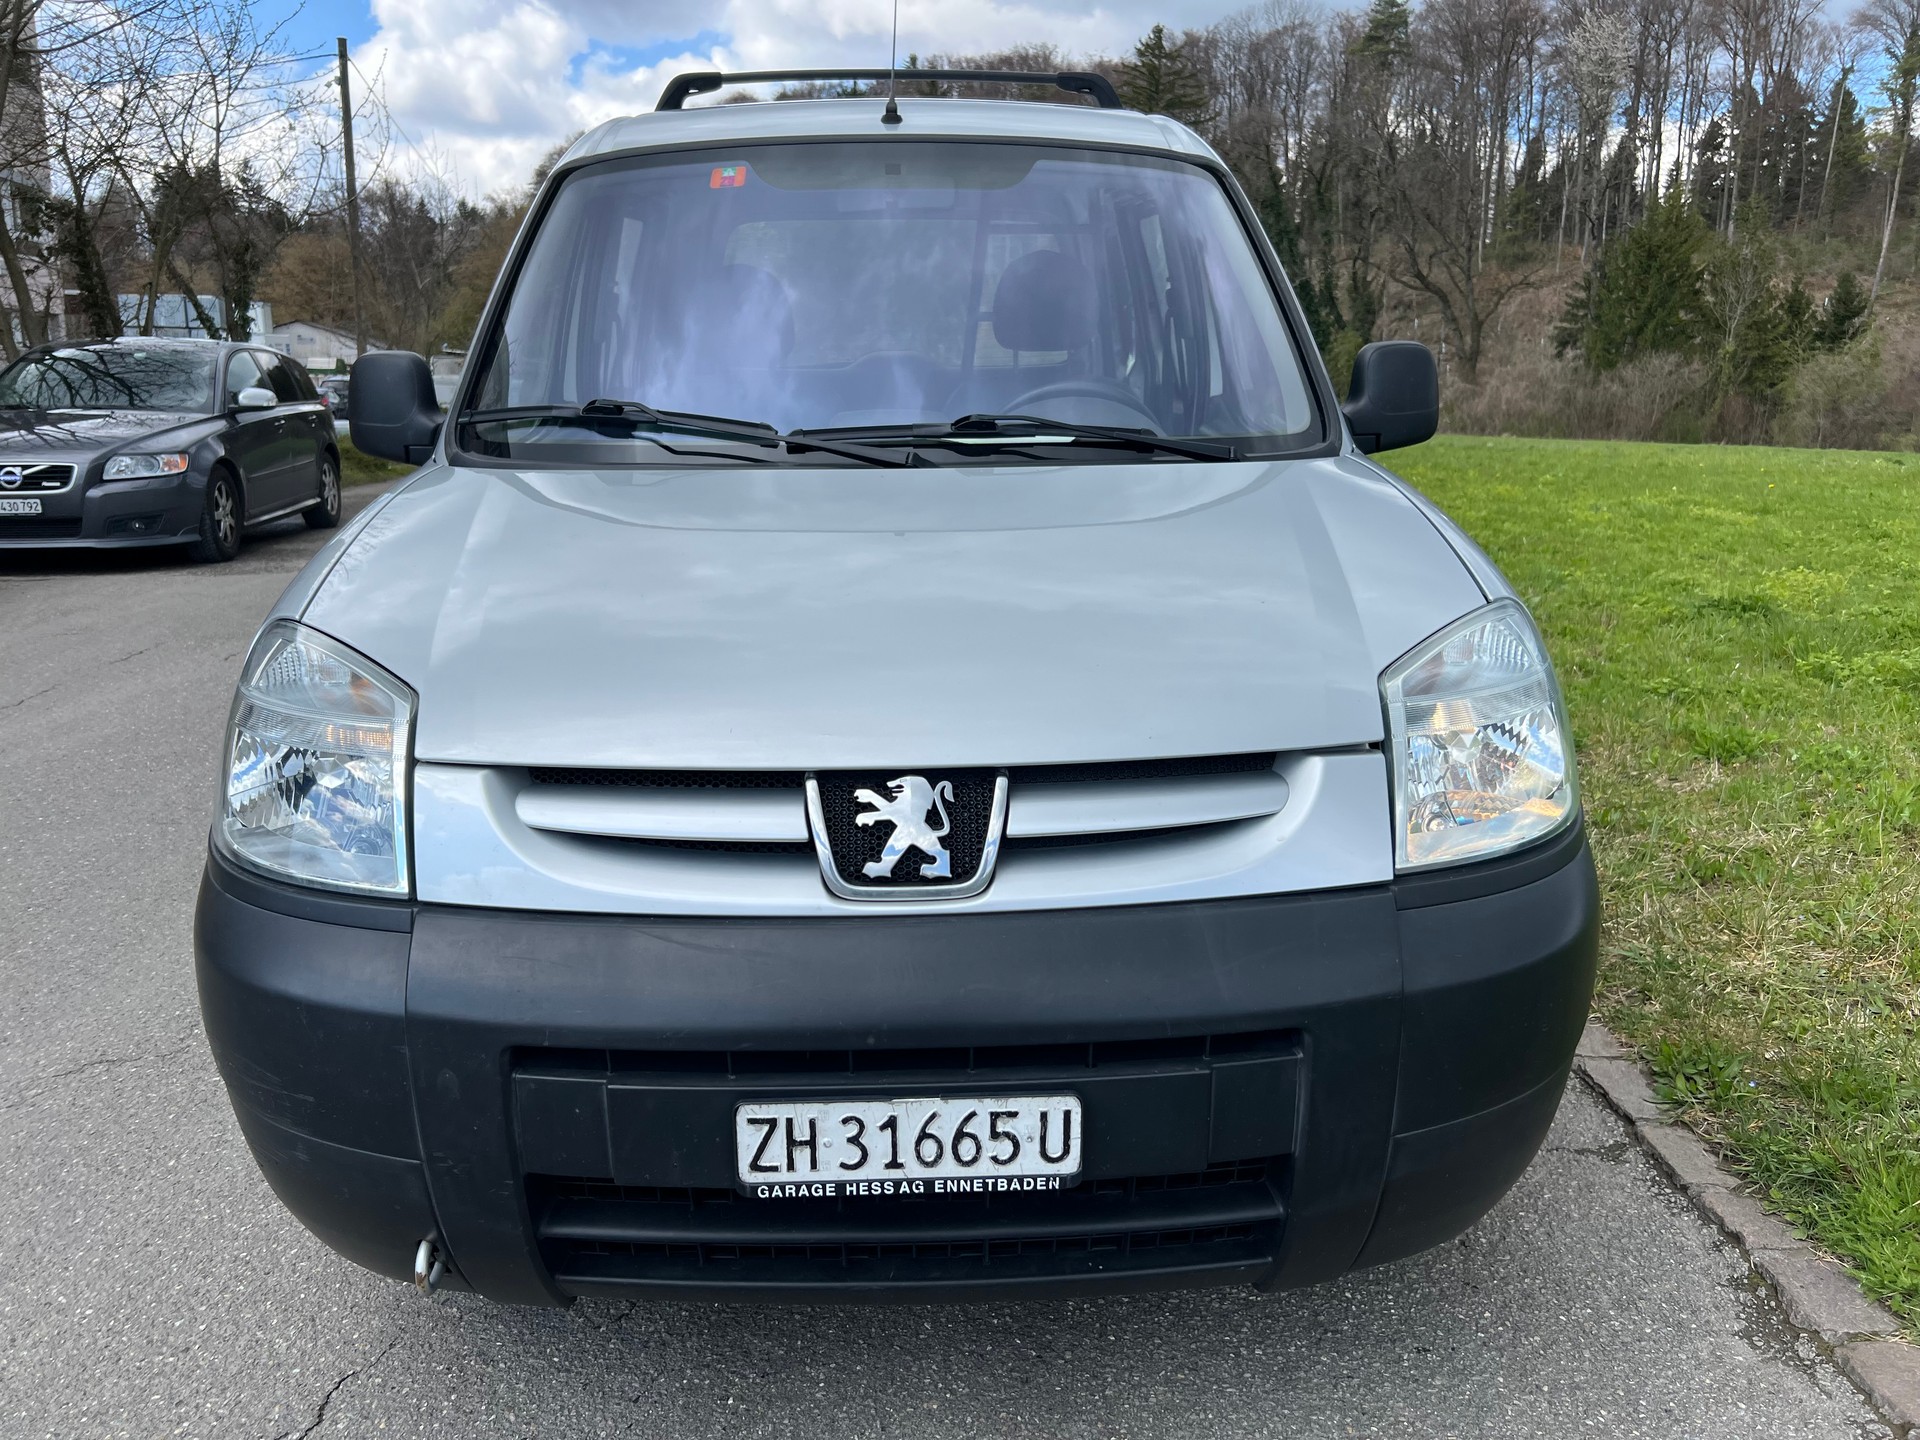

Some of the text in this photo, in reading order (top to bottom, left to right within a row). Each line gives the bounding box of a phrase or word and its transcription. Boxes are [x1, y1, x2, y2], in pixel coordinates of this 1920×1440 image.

[746, 1108, 1072, 1172] ZH 31665 U
[757, 1176, 1060, 1199] GARAGE HESS AG ENNETBADEN
